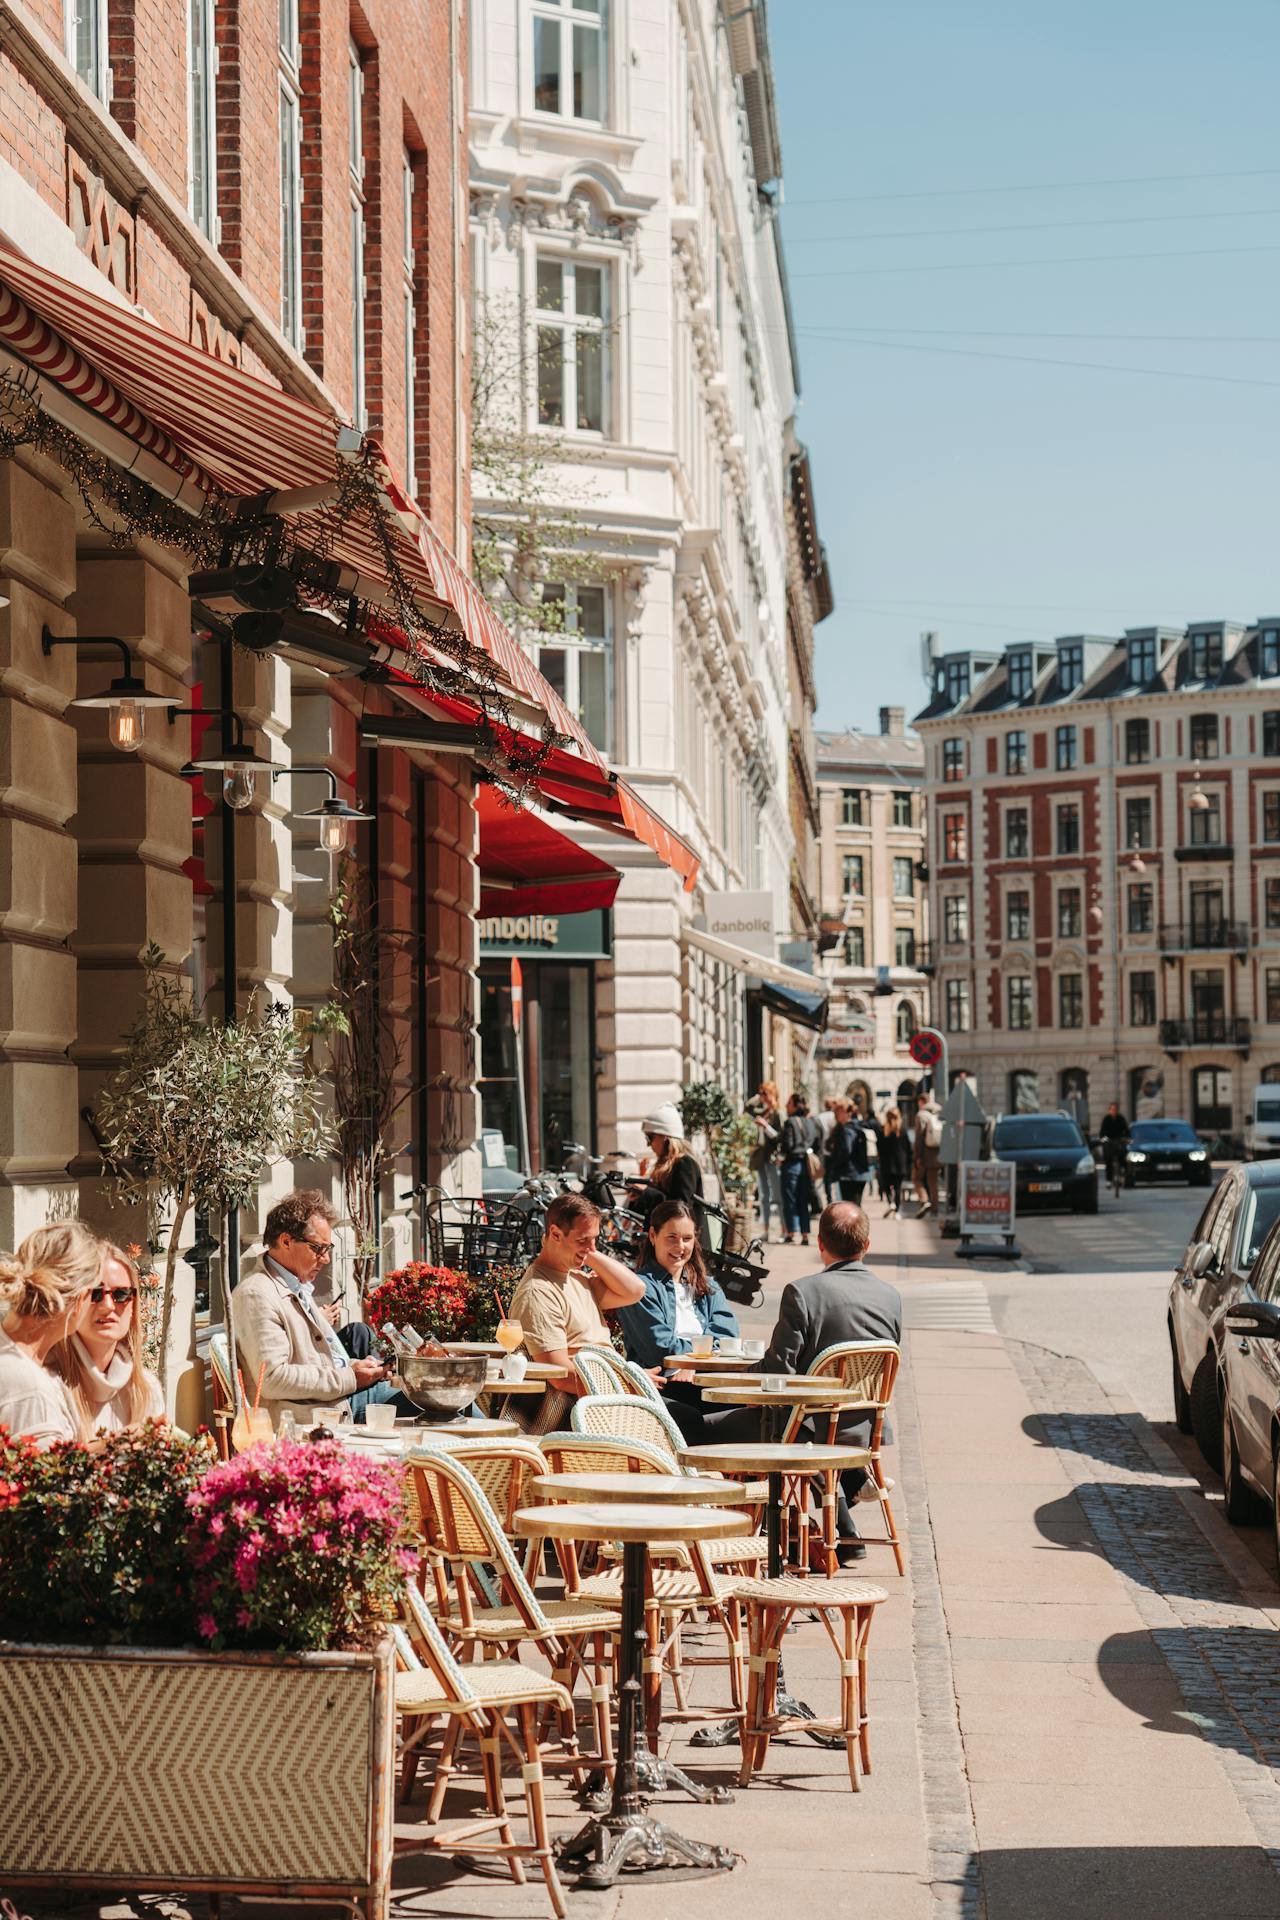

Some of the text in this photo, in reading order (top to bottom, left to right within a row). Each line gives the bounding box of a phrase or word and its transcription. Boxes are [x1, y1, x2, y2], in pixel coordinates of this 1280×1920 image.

[480, 915, 559, 944] anbolig
[711, 919, 771, 933] danbolig
[968, 1197, 1009, 1209] SOLGT
